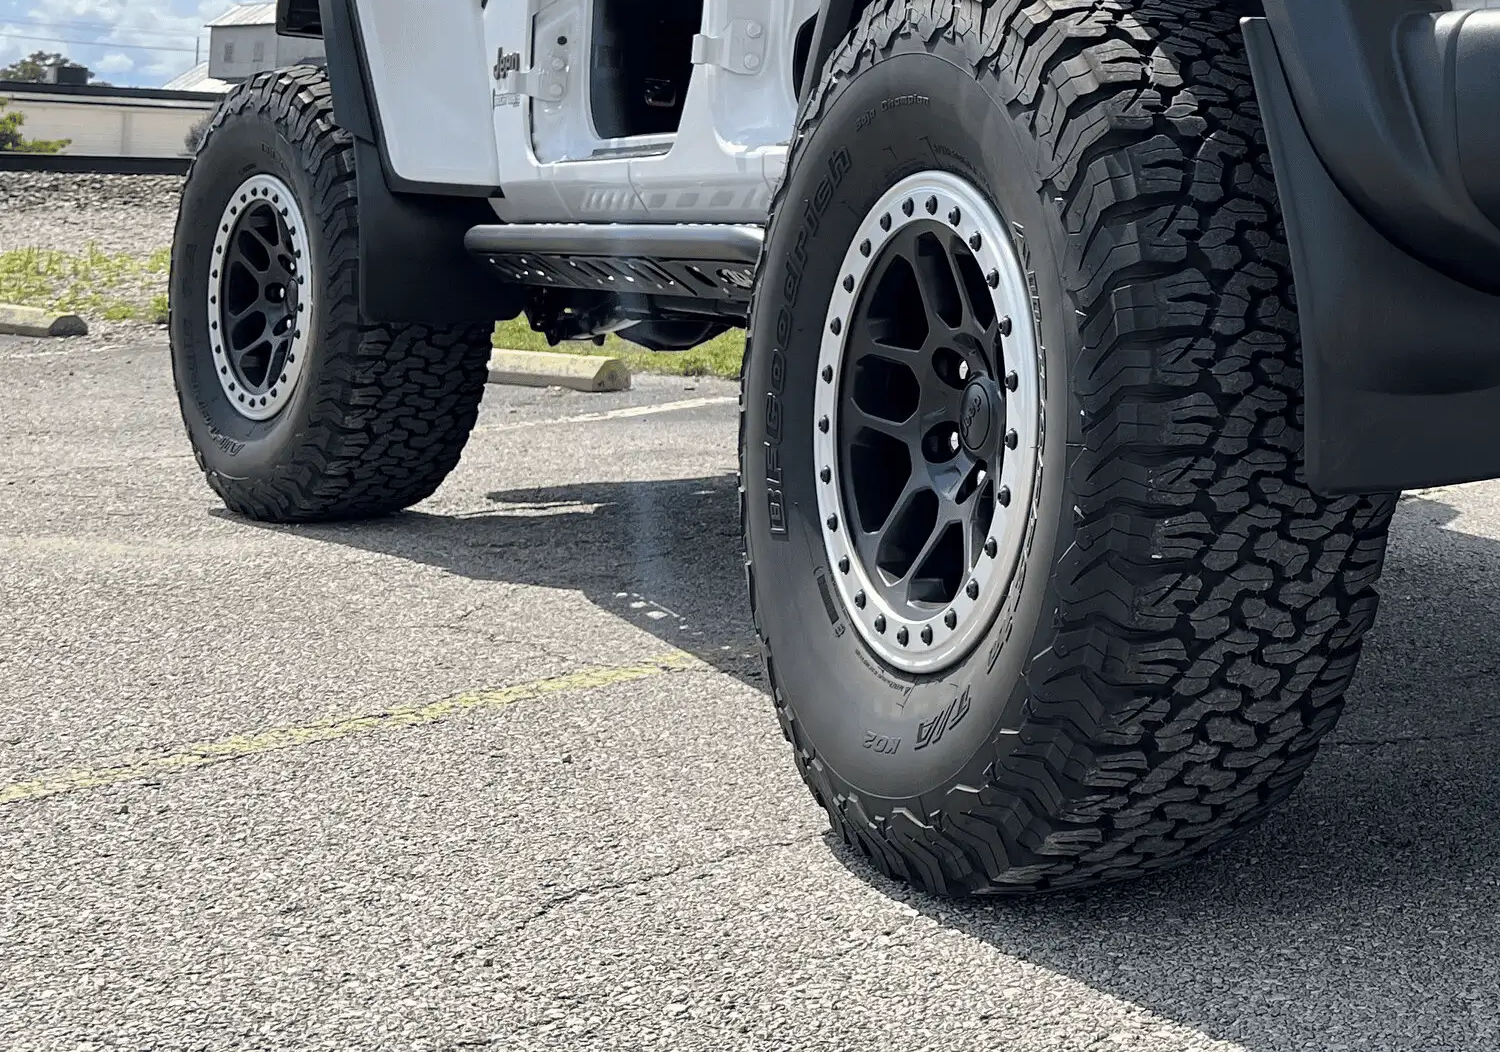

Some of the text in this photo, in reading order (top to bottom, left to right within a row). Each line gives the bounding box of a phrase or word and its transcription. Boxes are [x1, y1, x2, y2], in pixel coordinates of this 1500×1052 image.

[764, 145, 852, 536] BFGoodrich
[862, 684, 971, 755] T/A KO2
